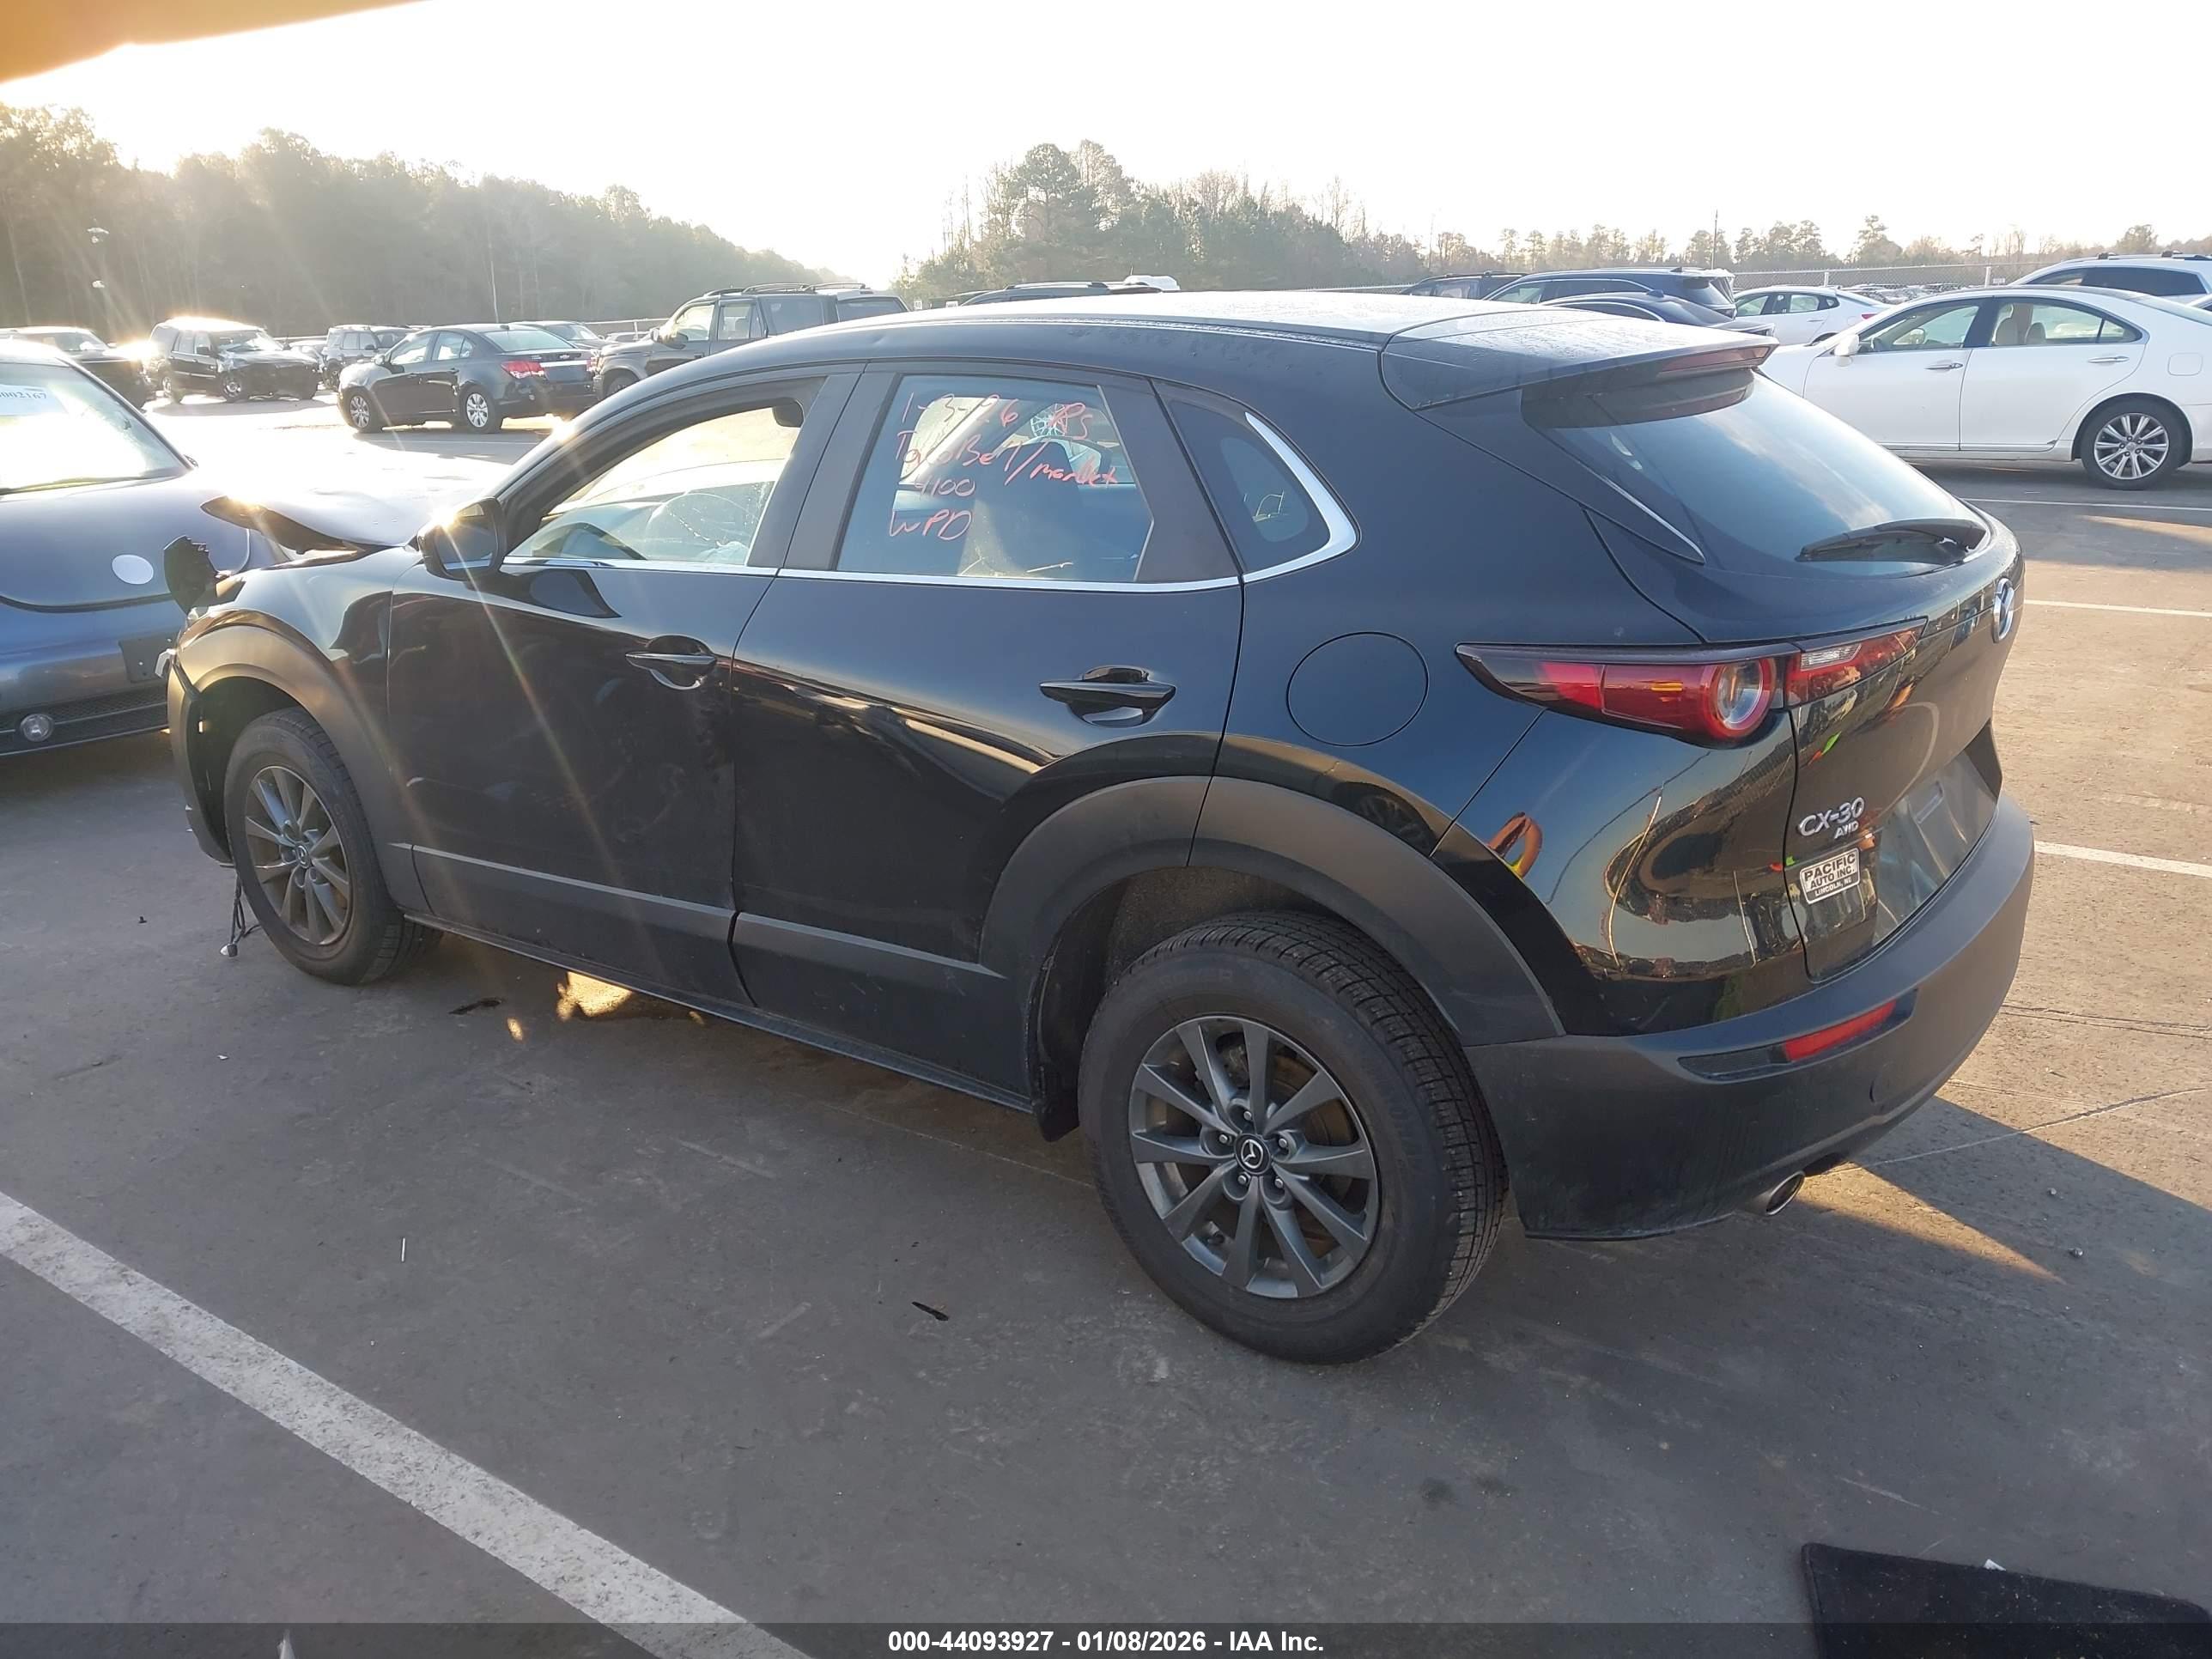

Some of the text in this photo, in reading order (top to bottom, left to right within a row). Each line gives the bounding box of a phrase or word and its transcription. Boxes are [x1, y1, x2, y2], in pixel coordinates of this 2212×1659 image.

[1798, 796, 1865, 837] CX-30
[1833, 820, 1859, 840] AWD
[1804, 853, 1856, 882] PACIFIC
[1810, 865, 1855, 890] AUTO INC.
